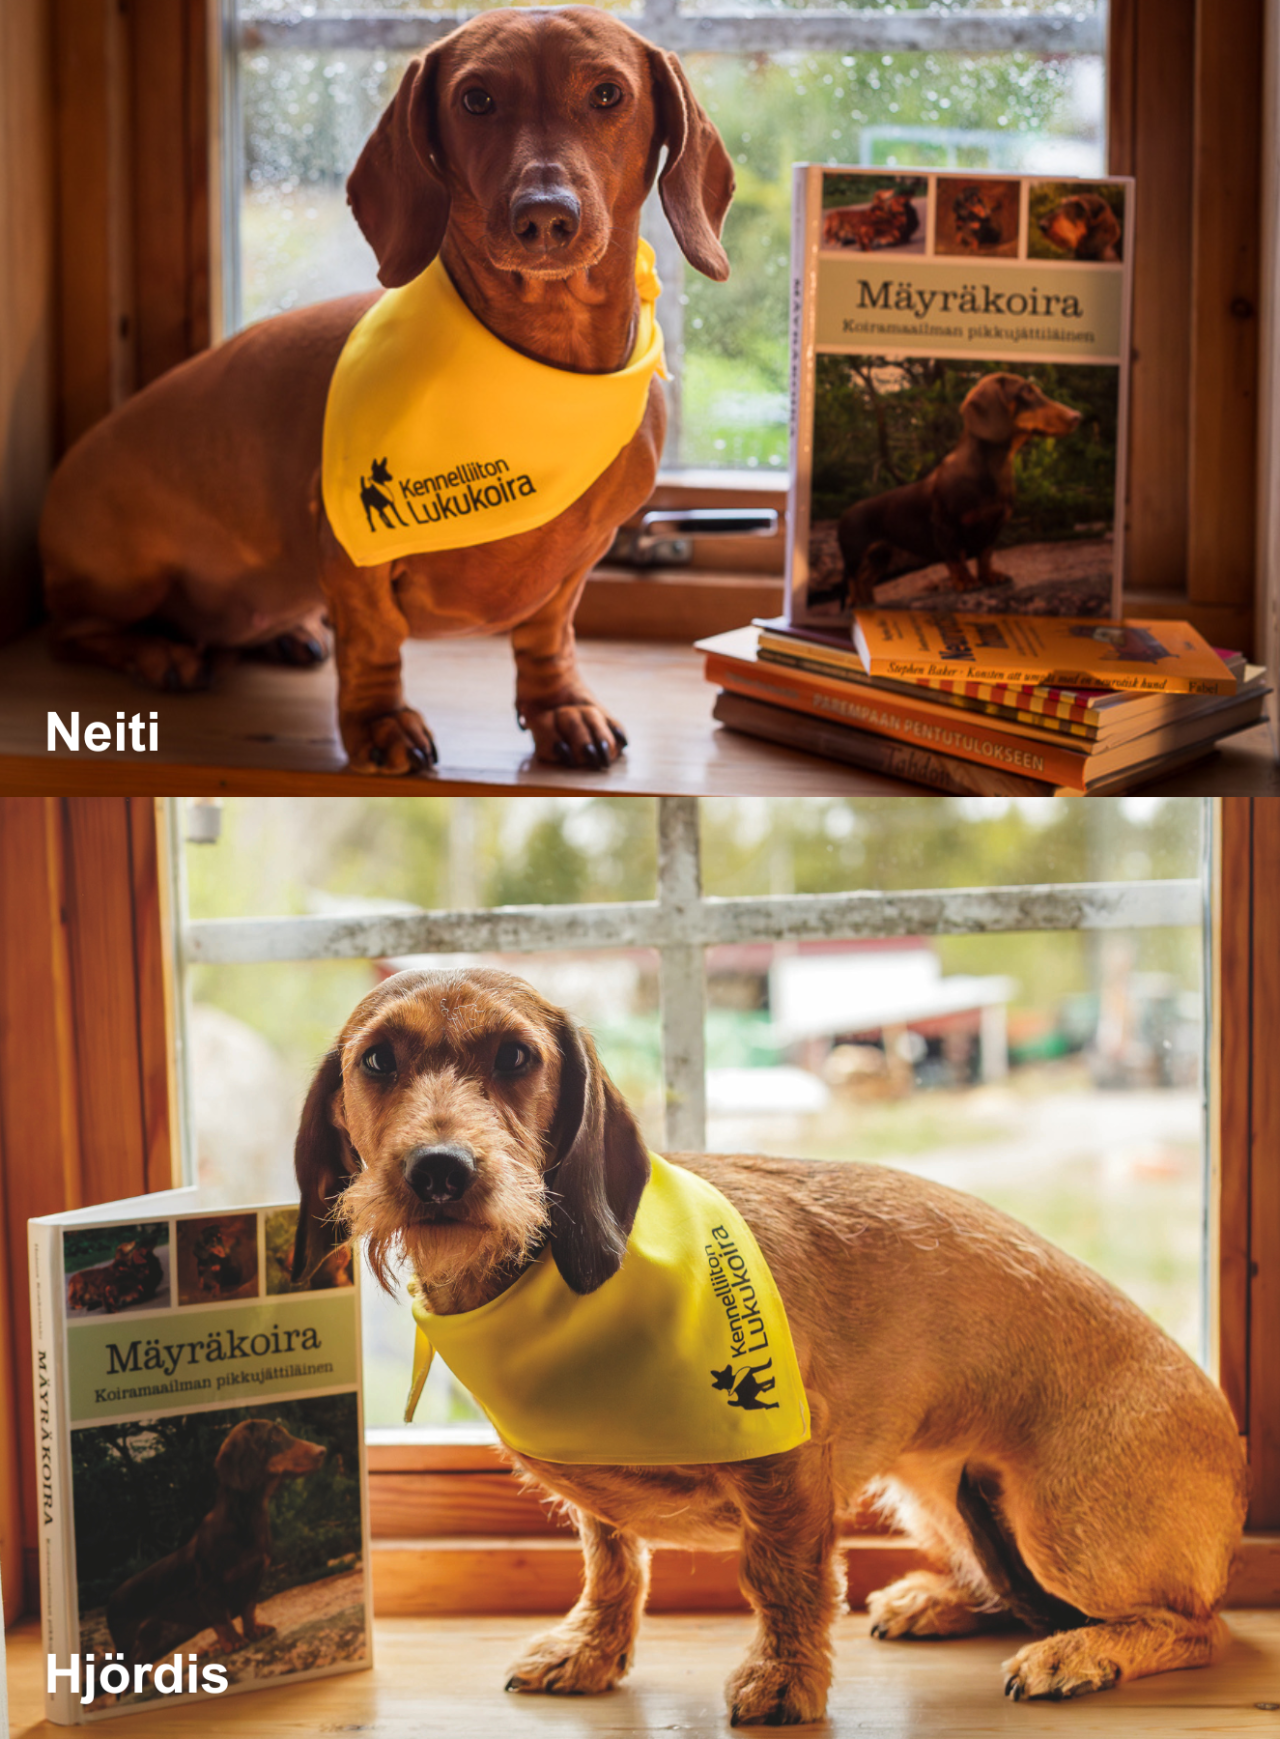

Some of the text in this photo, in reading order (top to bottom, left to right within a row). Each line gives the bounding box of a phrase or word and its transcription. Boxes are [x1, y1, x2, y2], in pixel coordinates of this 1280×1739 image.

[856, 278, 1084, 319] Mäyräkoira
[842, 319, 1096, 344] Koiramaailman pikkujättiläinen
[398, 458, 510, 500] Kennelliiton
[406, 474, 537, 525] Lukukoira
[886, 661, 924, 676] Stephen
[927, 664, 957, 676] Baker
[966, 666, 1004, 680] Konsten
[1007, 670, 1022, 681] att
[1096, 675, 1139, 688] neurotisk
[1141, 677, 1168, 691] hund
[1188, 681, 1218, 695] Fabel
[812, 693, 1045, 772] PAREMPAAN PENTUTULOKSEEN
[704, 1244, 747, 1358] Kennelliiton
[711, 1224, 769, 1353] Lukukoira
[105, 1324, 322, 1376] Mäyräkoira
[94, 1362, 334, 1403] Koiramaailman pikkujättiläinen
[37, 1350, 54, 1526] MÄYRÄKOIRA
